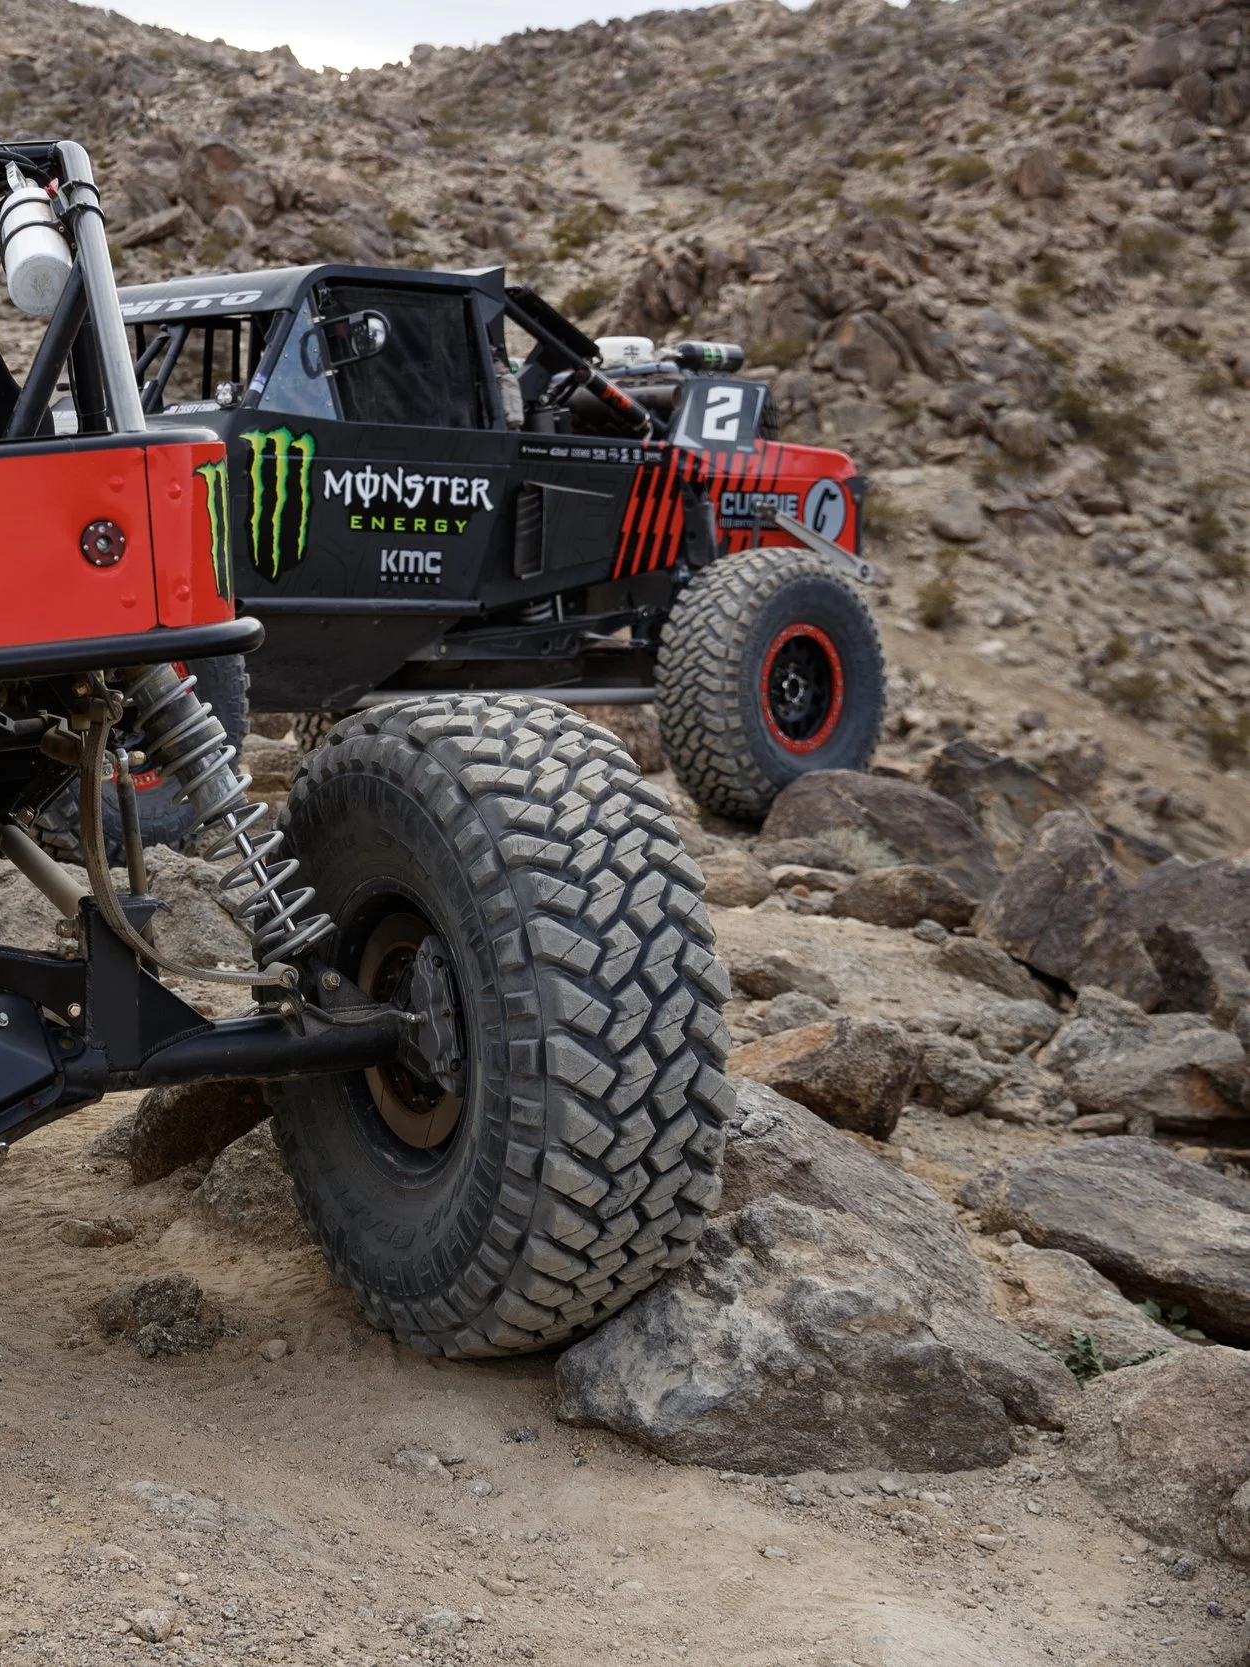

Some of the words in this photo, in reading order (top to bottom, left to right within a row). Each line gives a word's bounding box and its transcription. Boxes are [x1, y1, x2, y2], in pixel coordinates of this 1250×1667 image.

[120, 290, 263, 316] NITTO
[701, 386, 744, 441] 2
[323, 465, 494, 511] MONSTER
[350, 515, 468, 533] ENERGY
[380, 550, 442, 574] KMC
[380, 575, 440, 584] WHEELS
